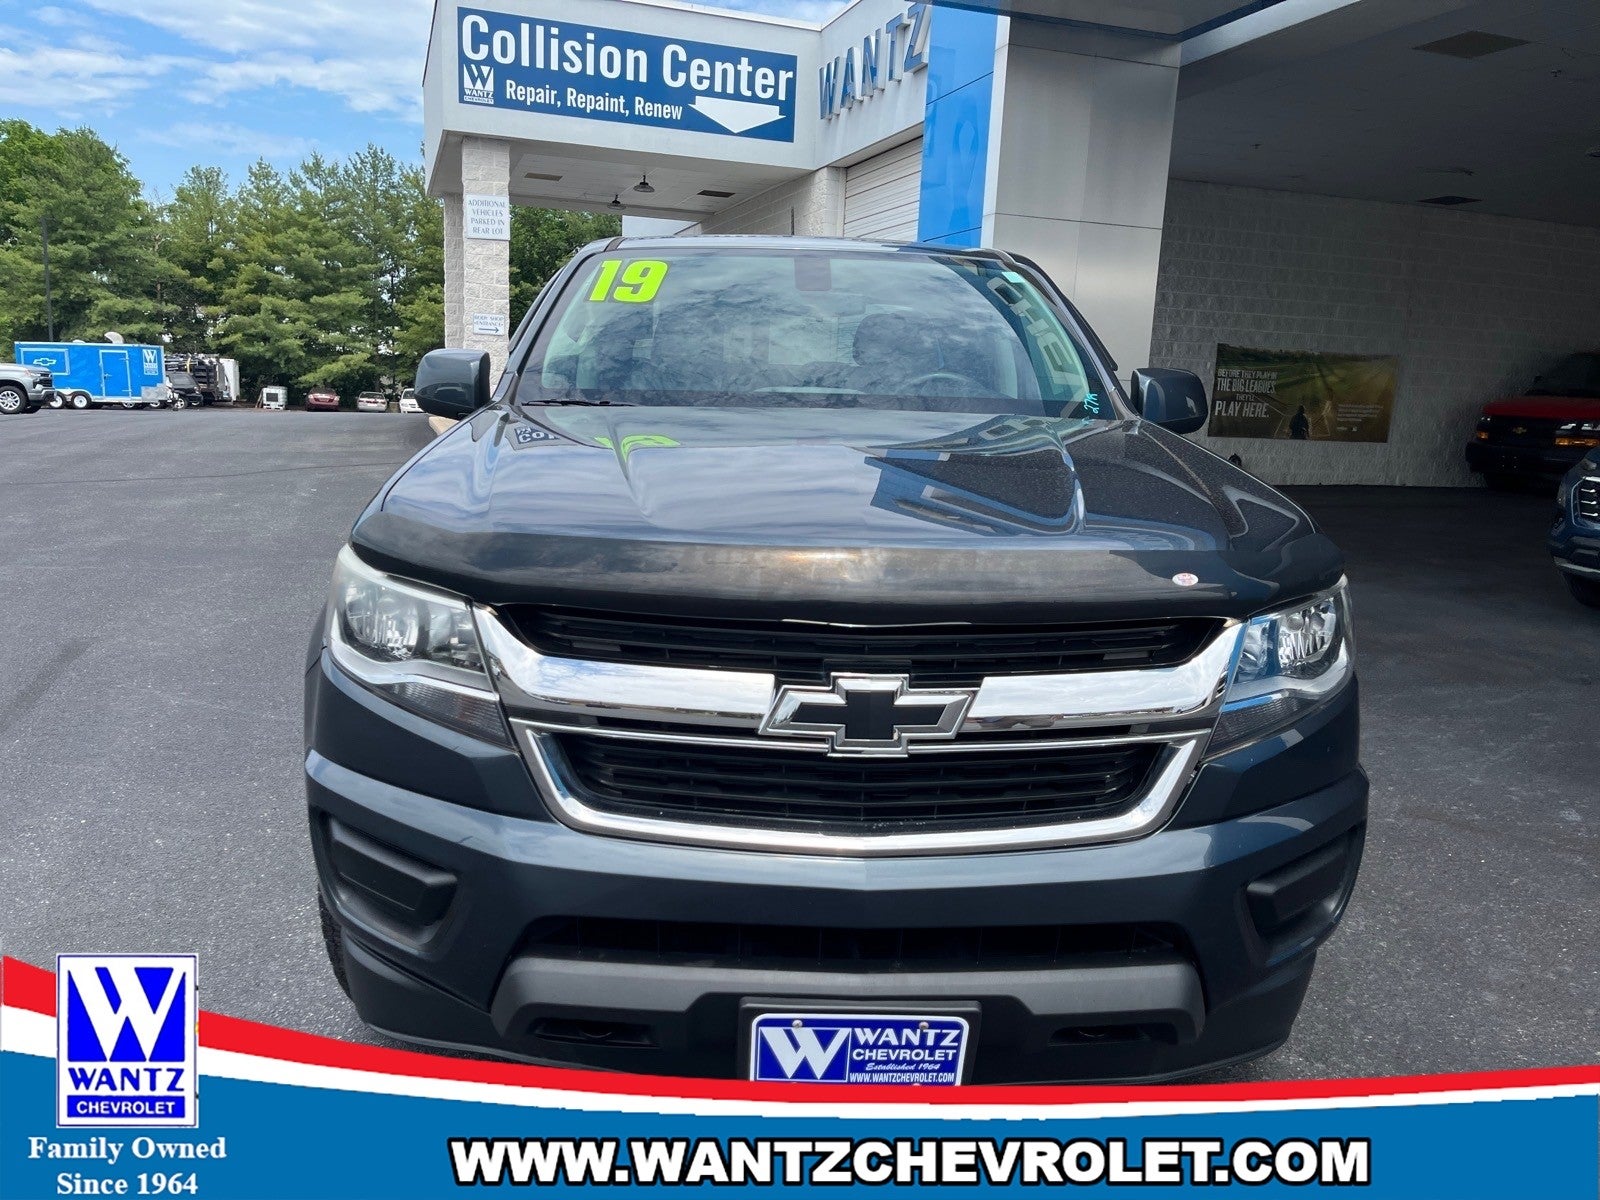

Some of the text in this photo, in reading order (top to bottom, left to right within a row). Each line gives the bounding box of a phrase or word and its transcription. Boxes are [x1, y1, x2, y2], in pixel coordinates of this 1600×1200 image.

[462, 14, 794, 101] Collision Center
[819, 3, 929, 120] WANTZ
[464, 88, 494, 98] WANTZ
[505, 79, 683, 120] Repair, Repaint, Renew
[468, 198, 505, 208] ADDITIONAL
[472, 208, 503, 217] VEHICLES
[470, 217, 496, 226] PARKED
[472, 226, 503, 235] REAR LOT
[589, 259, 669, 303] 19
[1218, 368, 1241, 378] BEFORE
[1241, 370, 1256, 379] THEY
[1256, 370, 1271, 380] PLAY
[1217, 377, 1231, 391] THE
[1232, 378, 1245, 392] BIG
[1214, 400, 1270, 418] PLAY HERE.
[853, 1027, 961, 1047] WANTZ
[761, 1027, 851, 1080] W
[852, 1048, 957, 1061] CHEVROLET
[865, 1062, 940, 1071] Established 1964
[849, 1072, 955, 1083] WWW.WANTZCHEVROLET.COM
